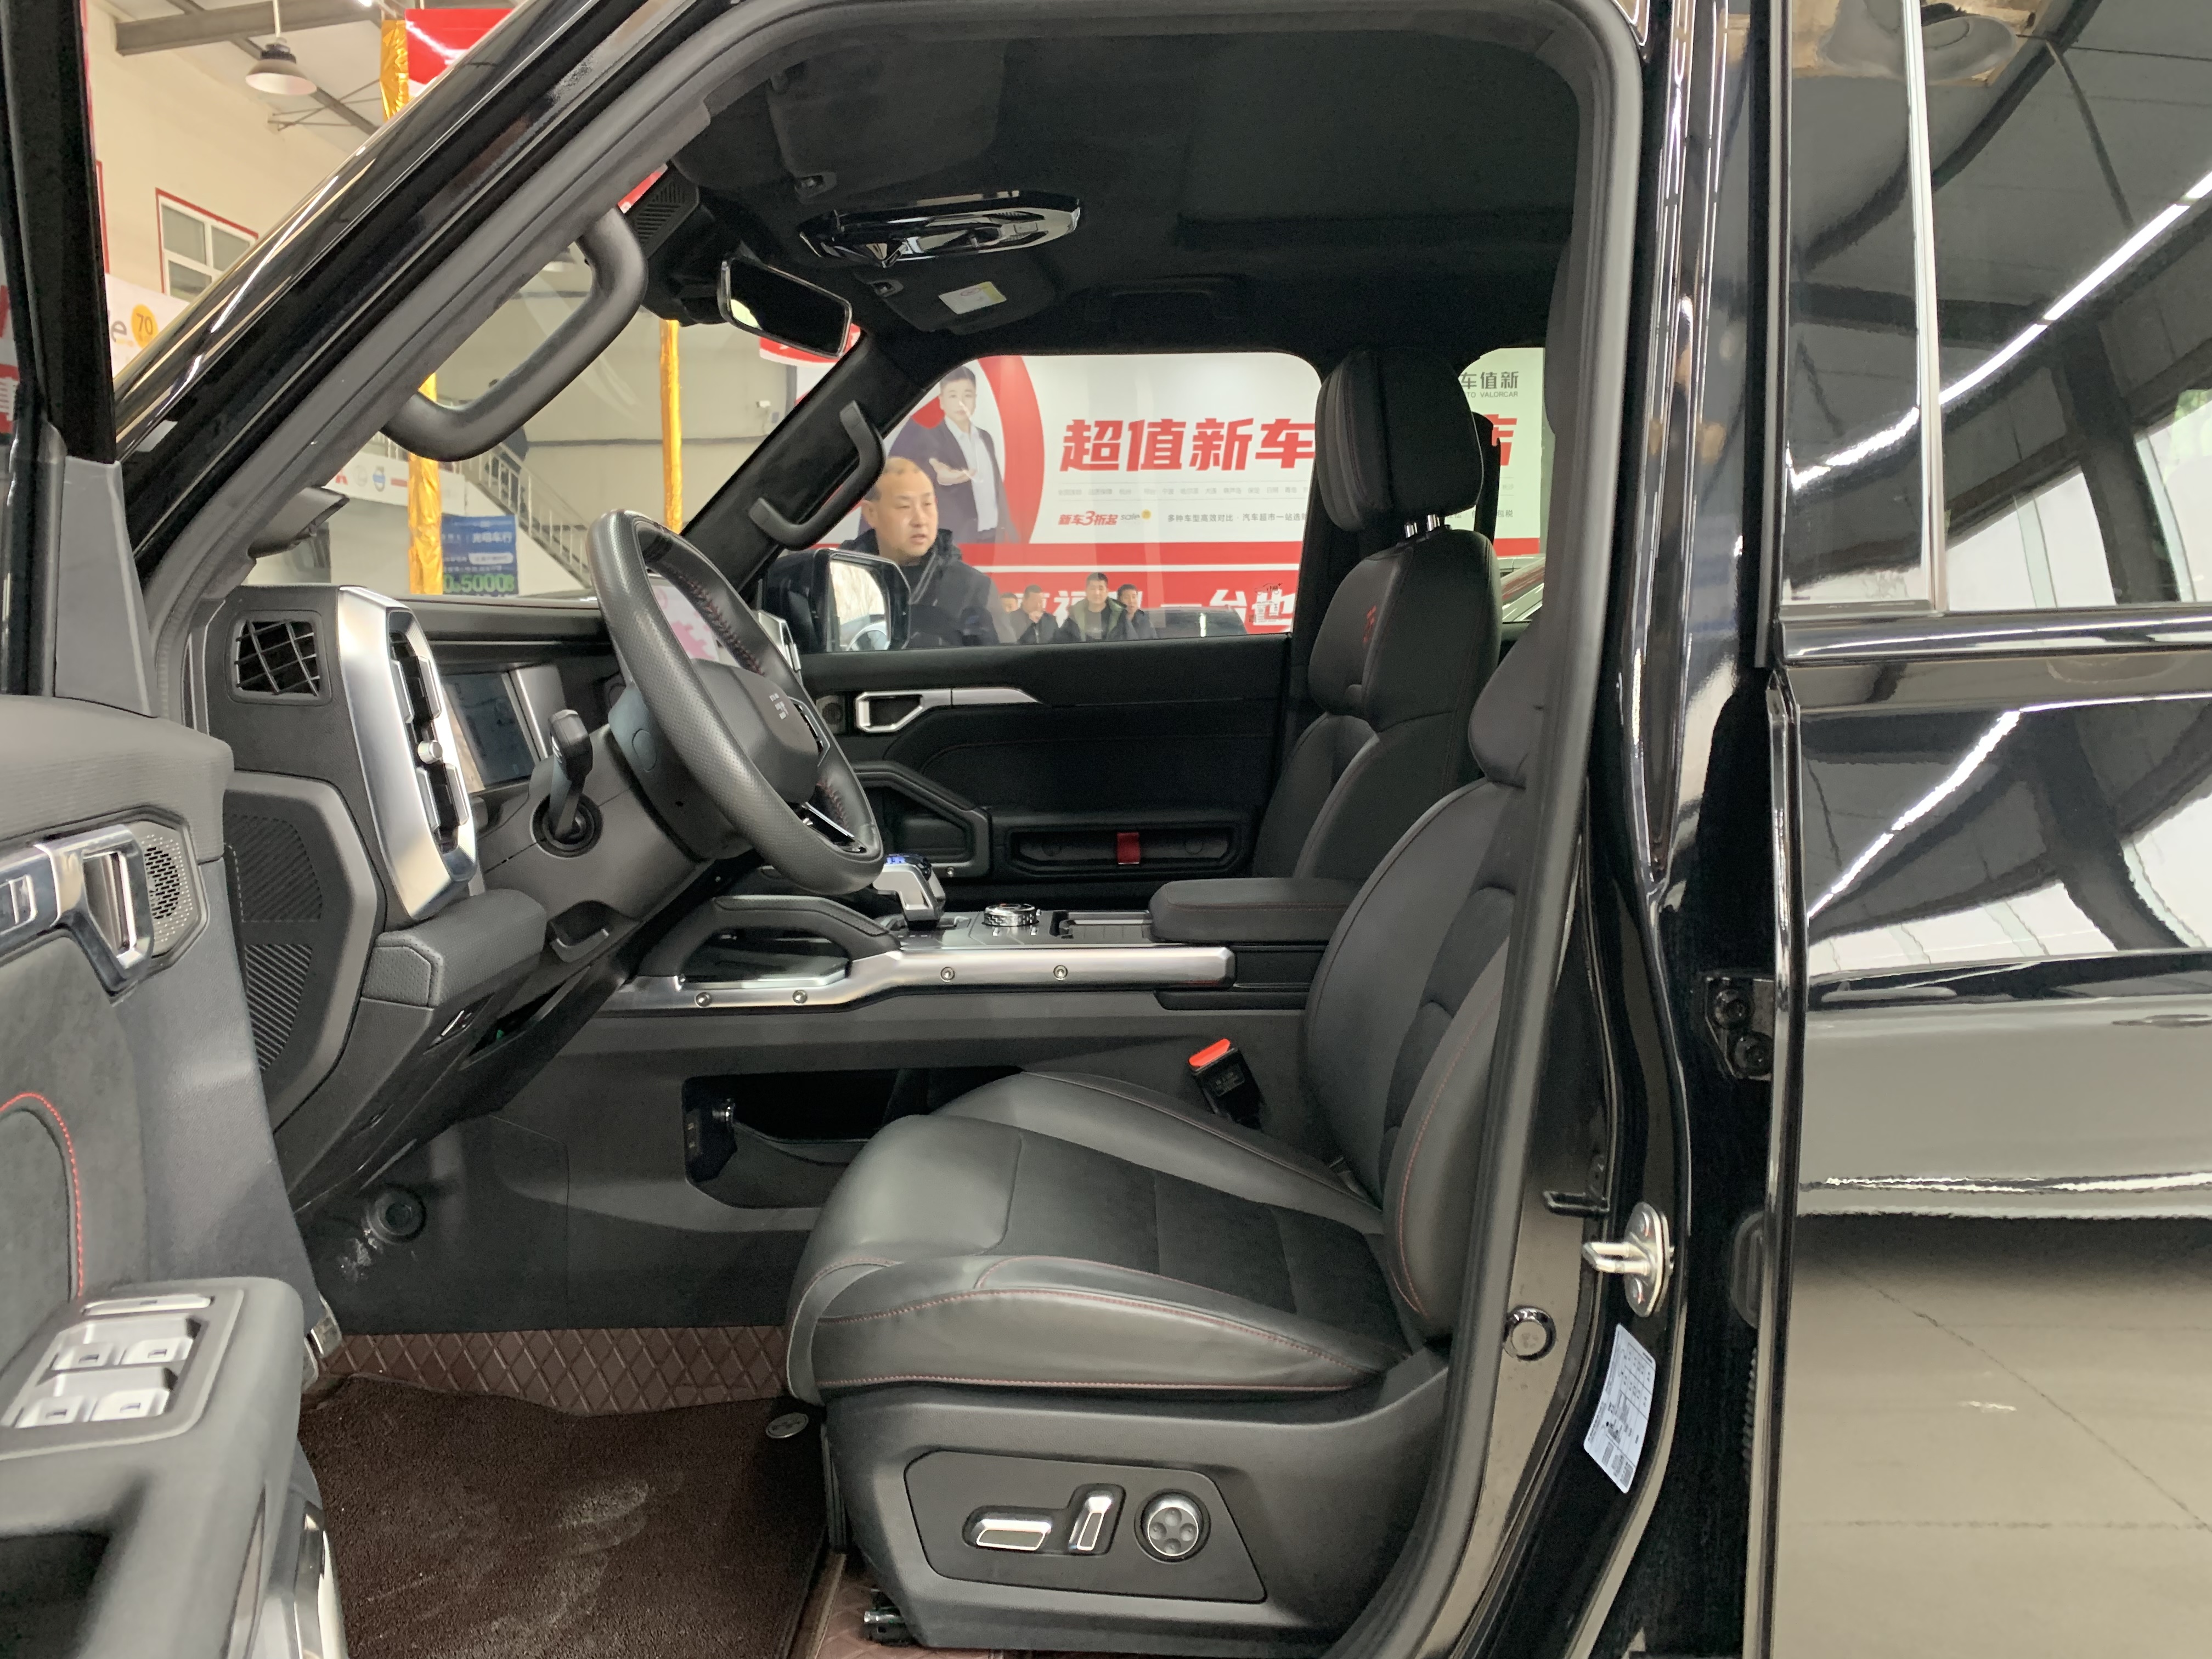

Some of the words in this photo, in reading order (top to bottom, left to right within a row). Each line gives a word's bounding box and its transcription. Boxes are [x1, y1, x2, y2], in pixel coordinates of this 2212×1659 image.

[136, 313, 154, 335] 70
[1059, 417, 1316, 472] 超值新车
